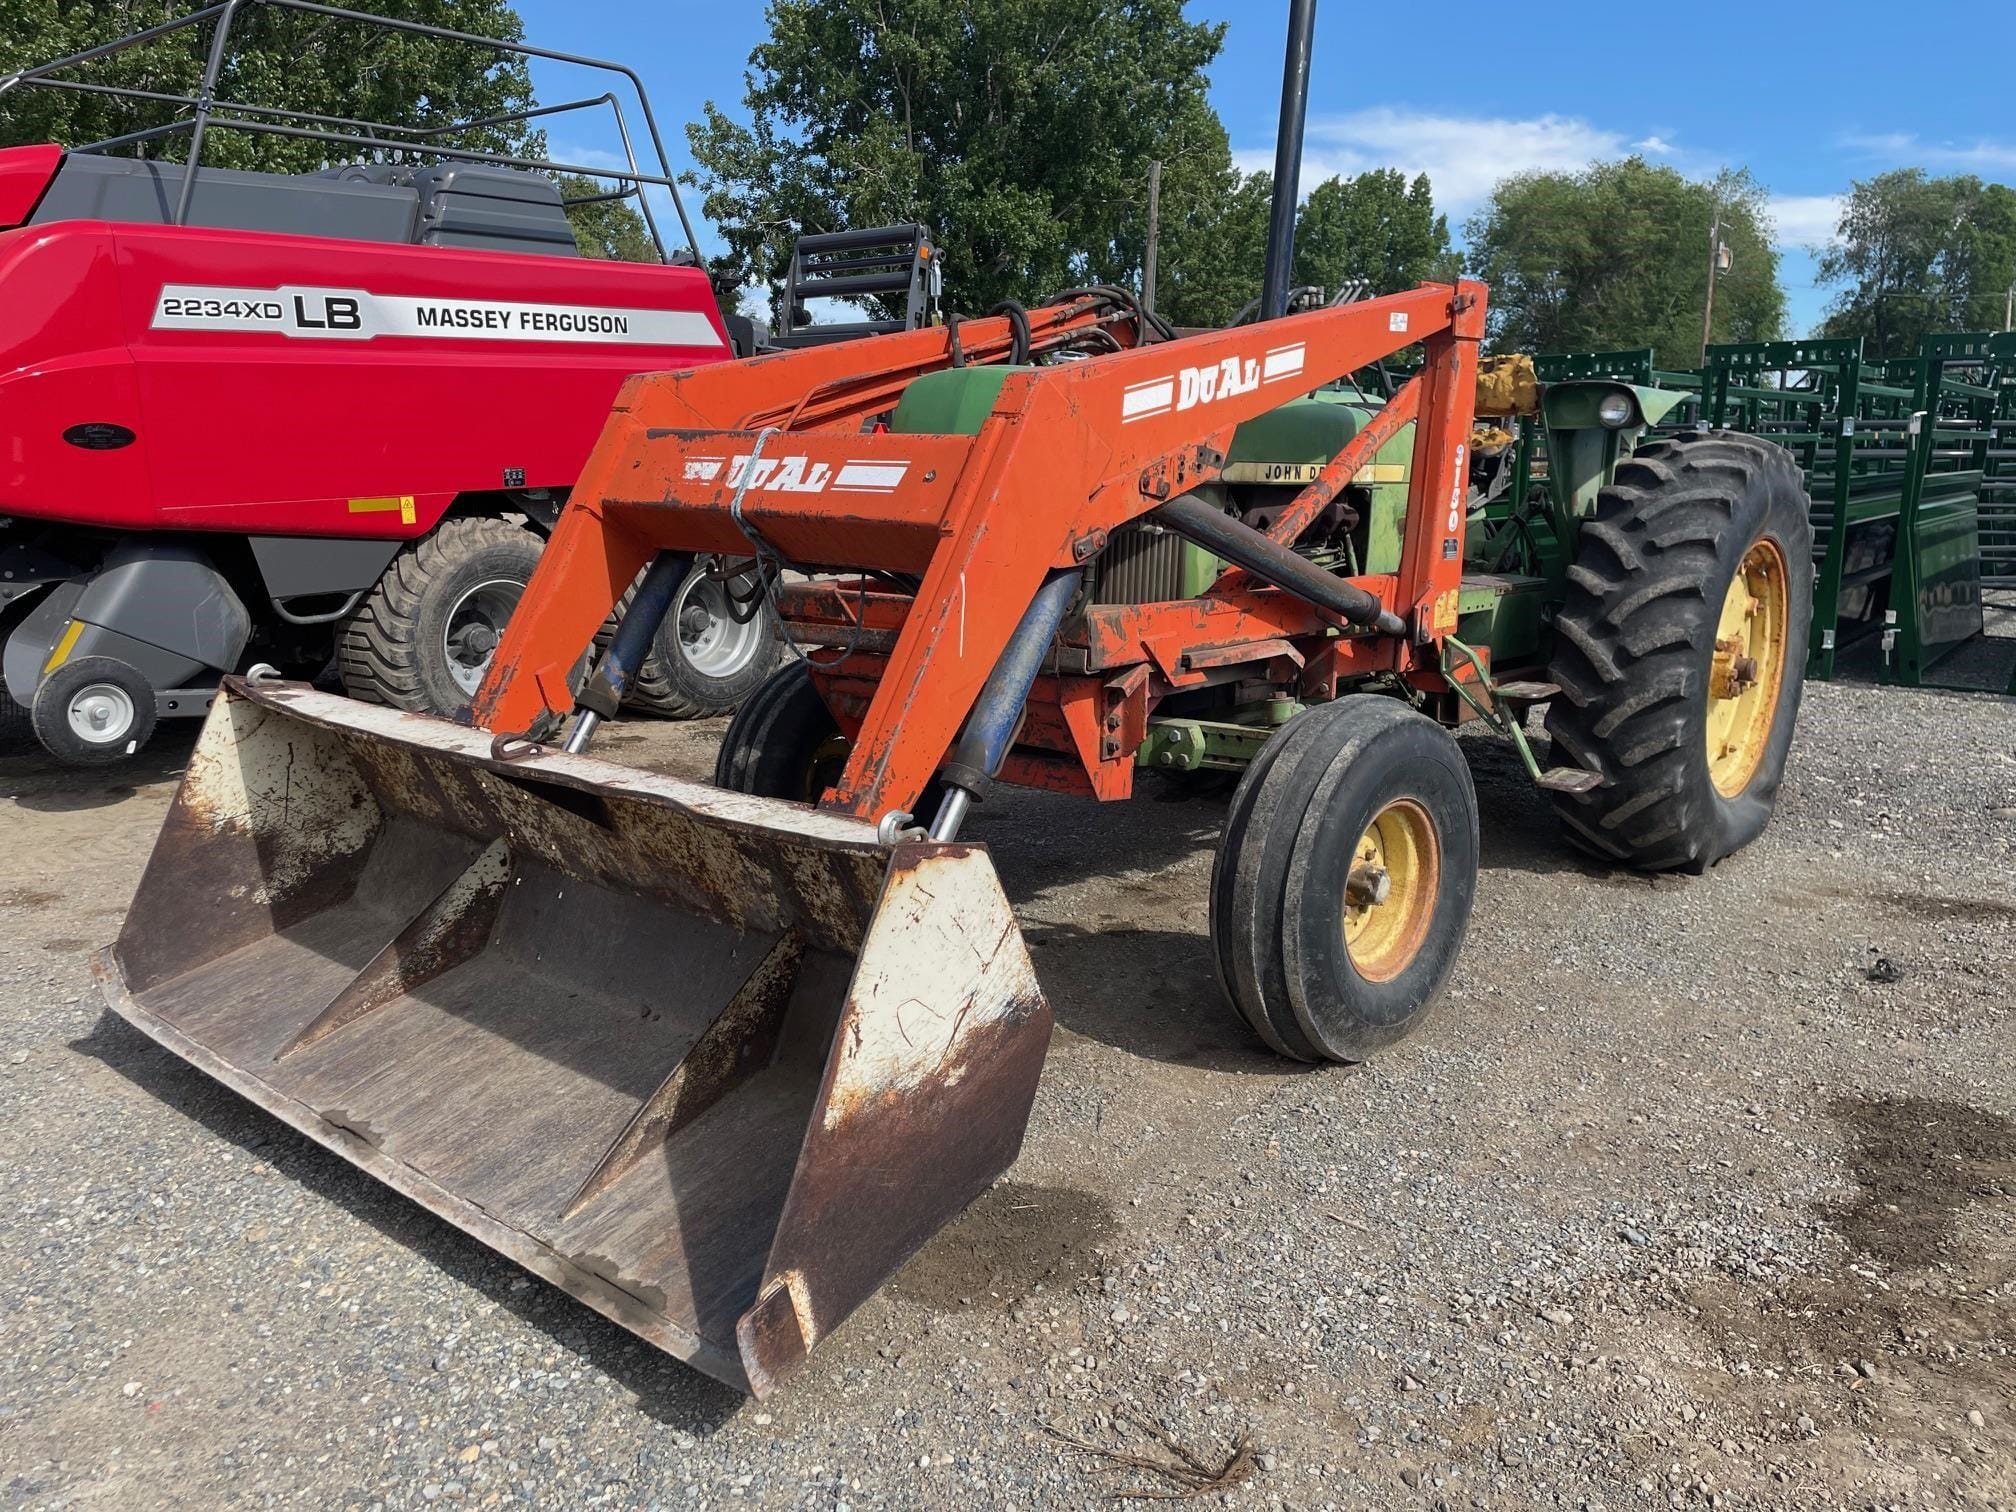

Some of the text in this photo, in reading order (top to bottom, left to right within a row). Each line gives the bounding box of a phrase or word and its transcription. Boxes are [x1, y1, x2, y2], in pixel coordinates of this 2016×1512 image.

[163, 294, 629, 334] 2234XD LB MASSEY FERGUSON
[1265, 465, 1301, 480] JOHN
